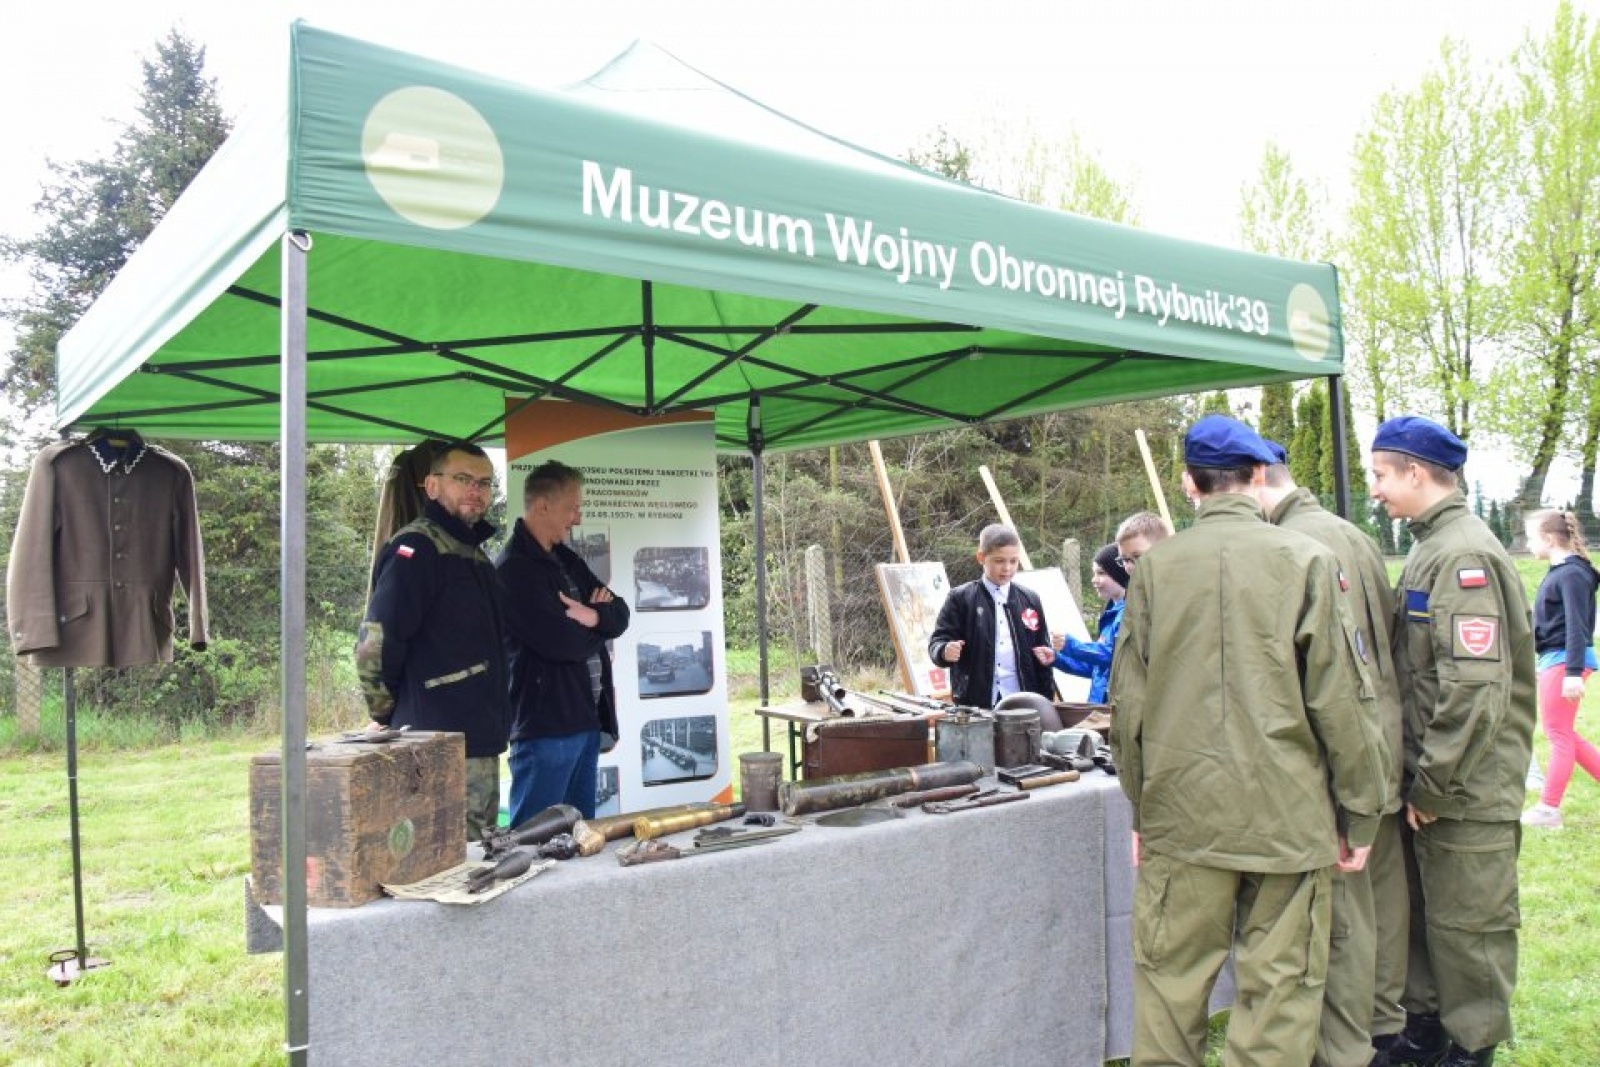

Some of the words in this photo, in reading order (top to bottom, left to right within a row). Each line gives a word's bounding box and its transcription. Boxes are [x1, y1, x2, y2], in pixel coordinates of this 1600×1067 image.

[582, 160, 814, 258] Muzeum
[825, 213, 957, 290] Wojny
[970, 241, 1126, 320] Obronnej
[1134, 275, 1269, 336] Rybnik'39
[609, 467, 654, 476] POLSKIEMU
